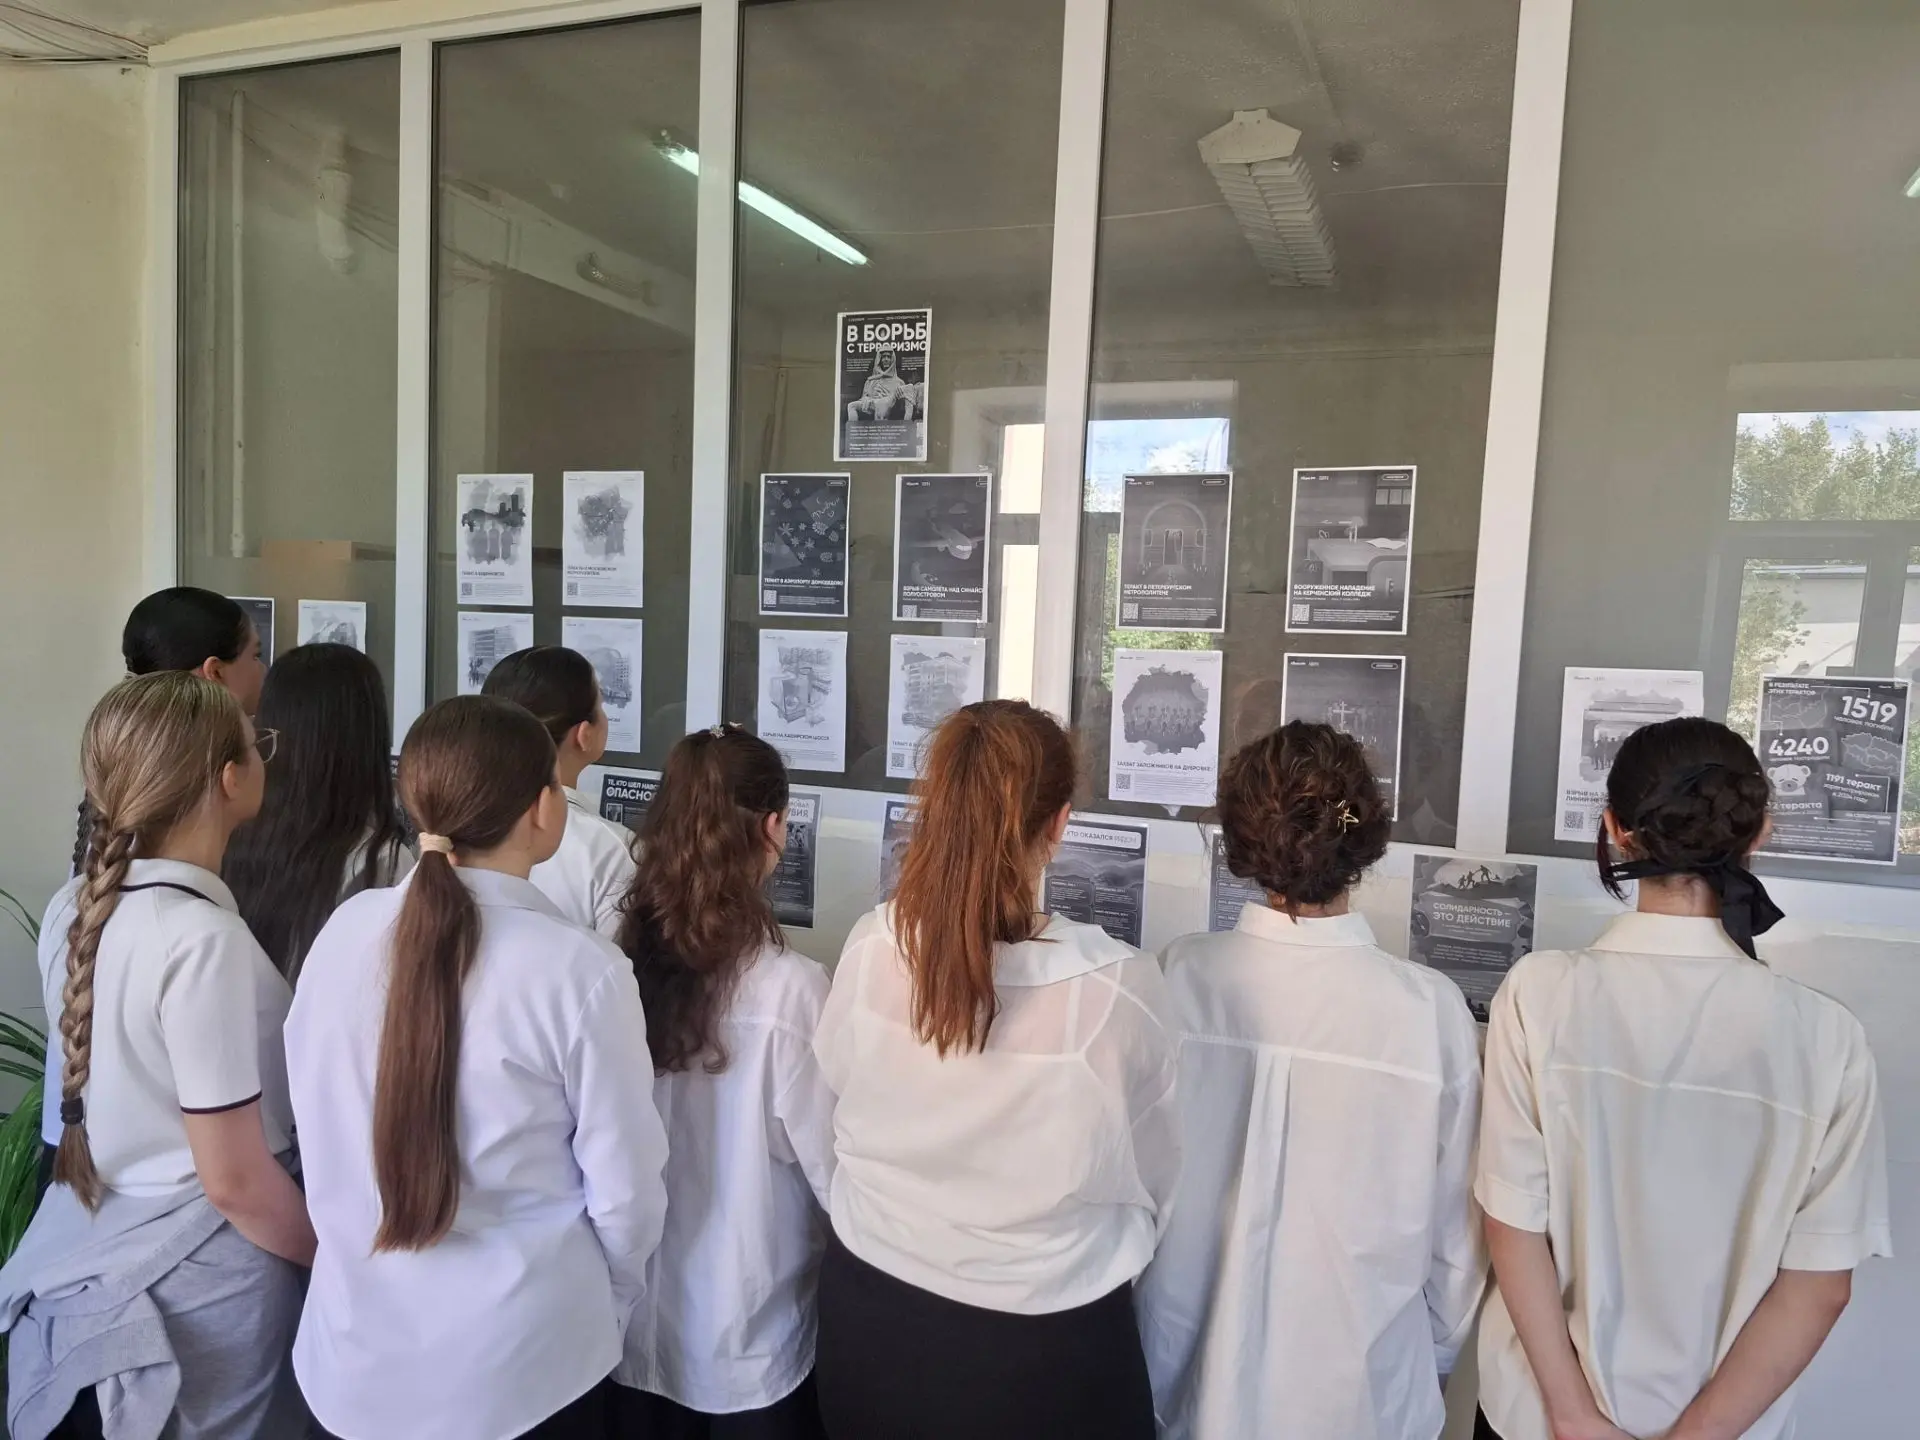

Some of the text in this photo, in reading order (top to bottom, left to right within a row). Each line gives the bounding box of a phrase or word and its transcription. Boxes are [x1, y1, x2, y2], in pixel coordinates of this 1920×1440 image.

[847, 322, 926, 342] В БОРЬБ
[847, 343, 855, 353] С
[1842, 696, 1897, 722] 1519
[1768, 736, 1829, 756] 4240
[1825, 773, 1882, 791] 1191 теракт
[1780, 802, 1823, 810] теракта
[1079, 832, 1113, 841] ОКАЗАЛСЯ
[1432, 902, 1503, 917] СОЛИДАРНОСТЬ
[1432, 911, 1511, 928] ЭТО ДЕЙСТВИЕ
